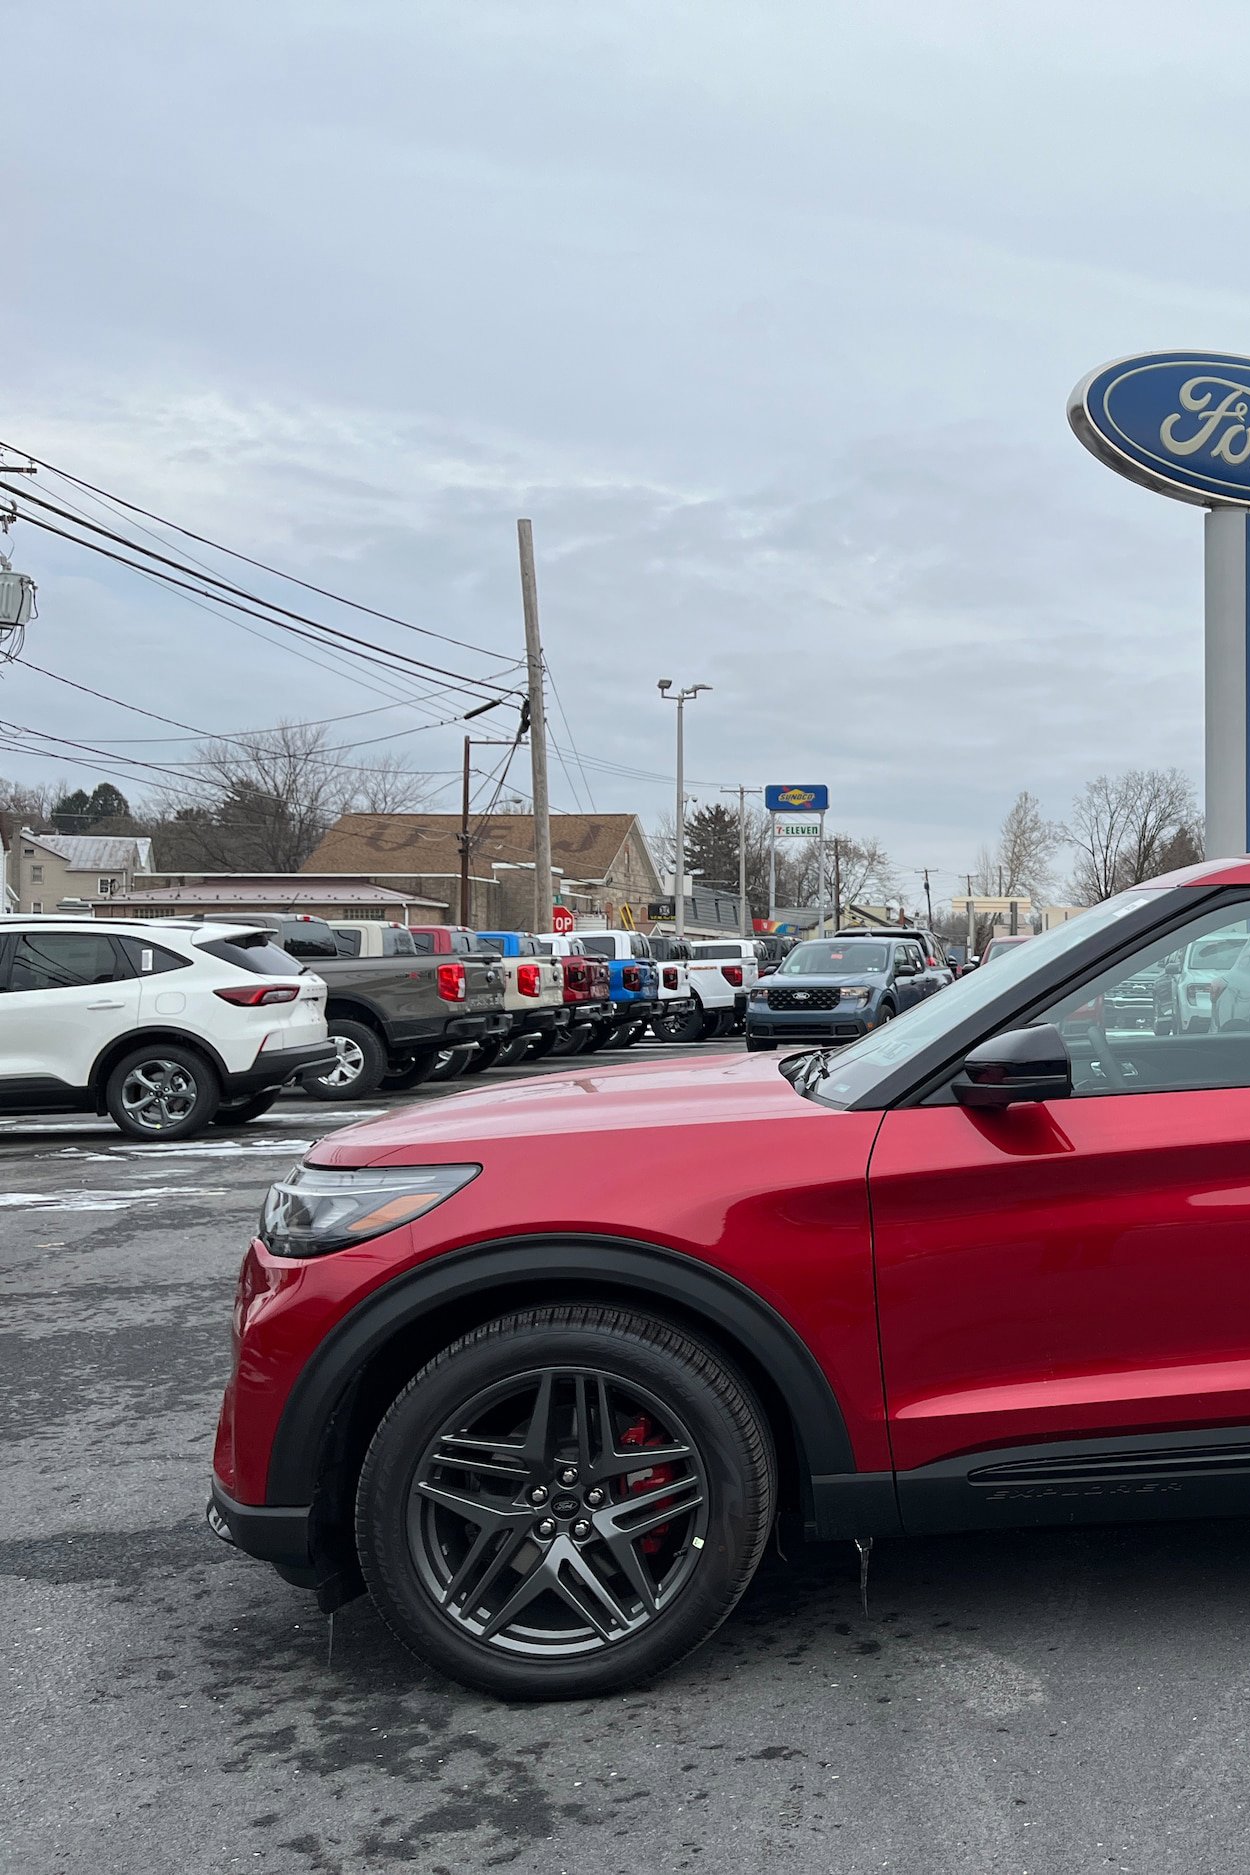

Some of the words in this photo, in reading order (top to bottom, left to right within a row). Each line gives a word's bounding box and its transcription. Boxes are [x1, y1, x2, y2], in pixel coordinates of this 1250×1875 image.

[779, 793, 815, 801] SUNOCO
[775, 825, 819, 835] 7-ELEVEN
[985, 1482, 1184, 1501] EXPLORER
